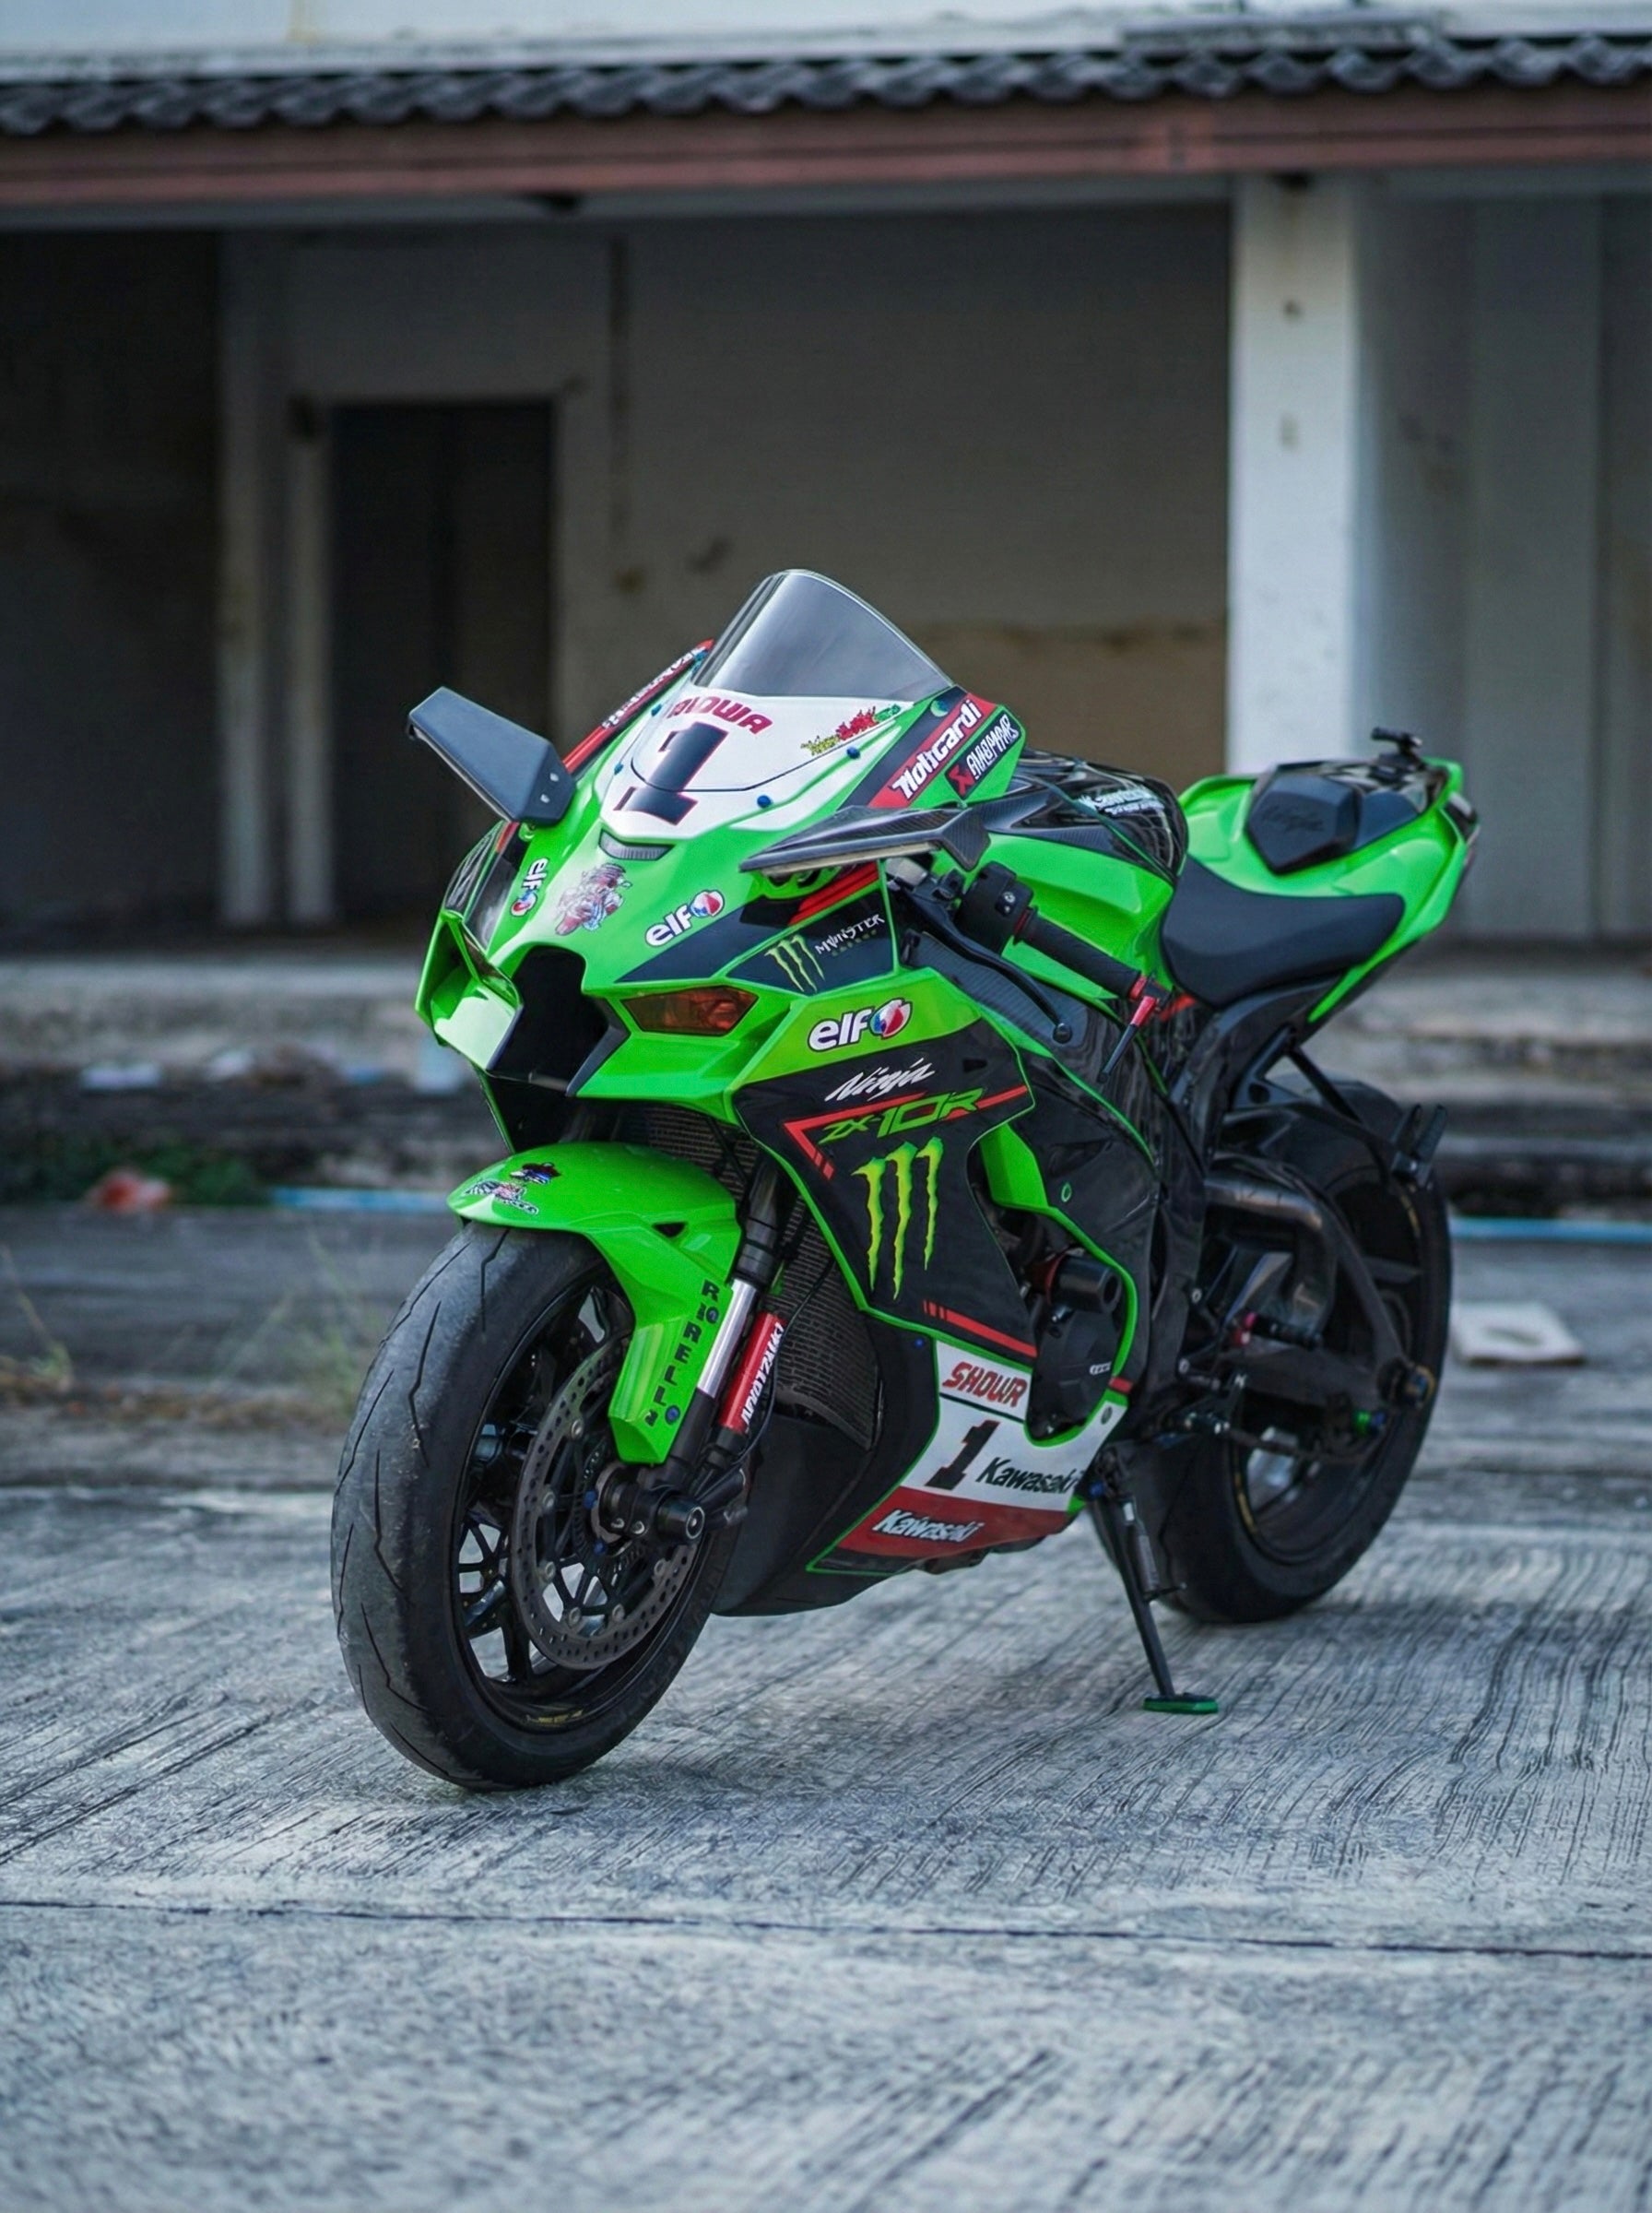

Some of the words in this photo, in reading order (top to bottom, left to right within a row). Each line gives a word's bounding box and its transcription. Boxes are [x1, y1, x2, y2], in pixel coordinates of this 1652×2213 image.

[613, 721, 729, 825] 1
[824, 1058, 936, 1102] Ninja
[924, 1419, 1001, 1491] 1
[975, 1456, 1086, 1495] Kawasaki
[871, 1509, 985, 1544] Kawasaki
